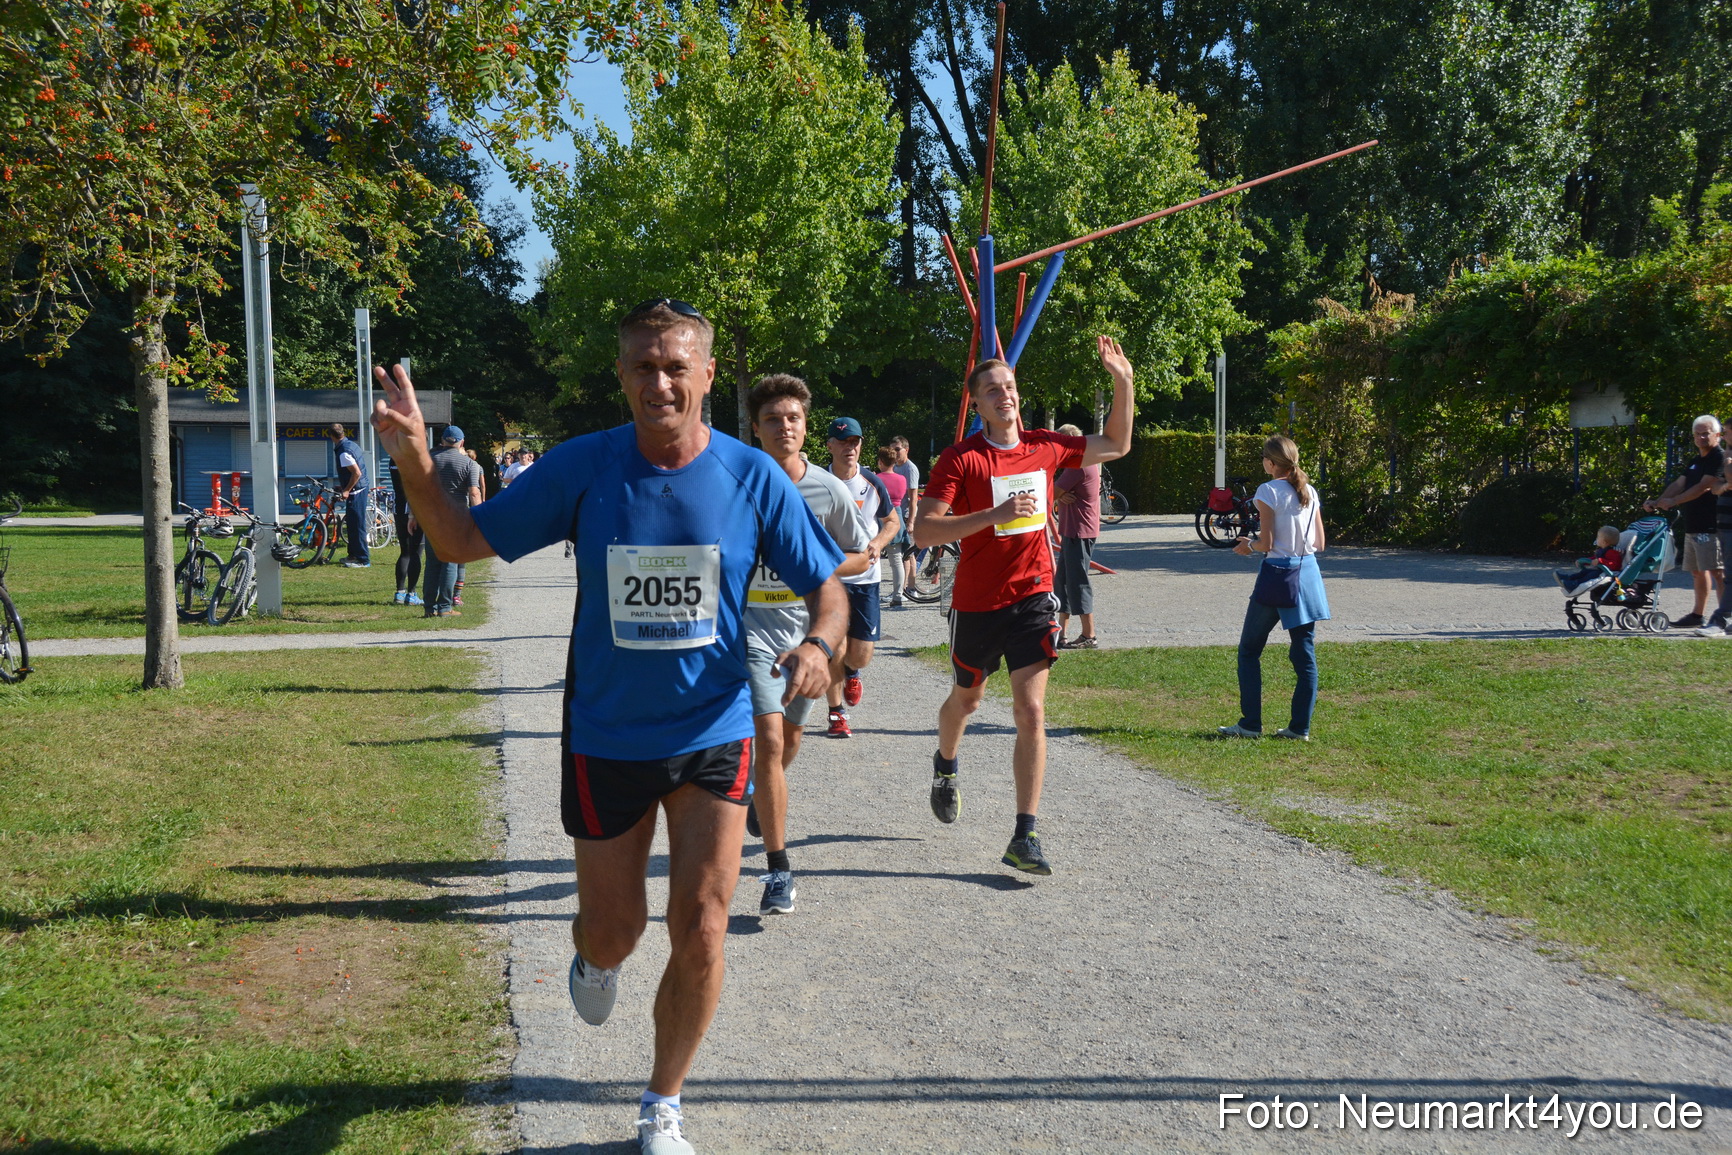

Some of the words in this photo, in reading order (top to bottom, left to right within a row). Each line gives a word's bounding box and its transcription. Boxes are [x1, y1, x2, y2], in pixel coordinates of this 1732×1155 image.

[285, 428, 315, 438] CAFE
[321, 428, 355, 438] KSK
[638, 556, 688, 568] BOCK
[623, 576, 702, 607] 2055
[764, 592, 789, 602] Viktor
[637, 624, 690, 639] Michael
